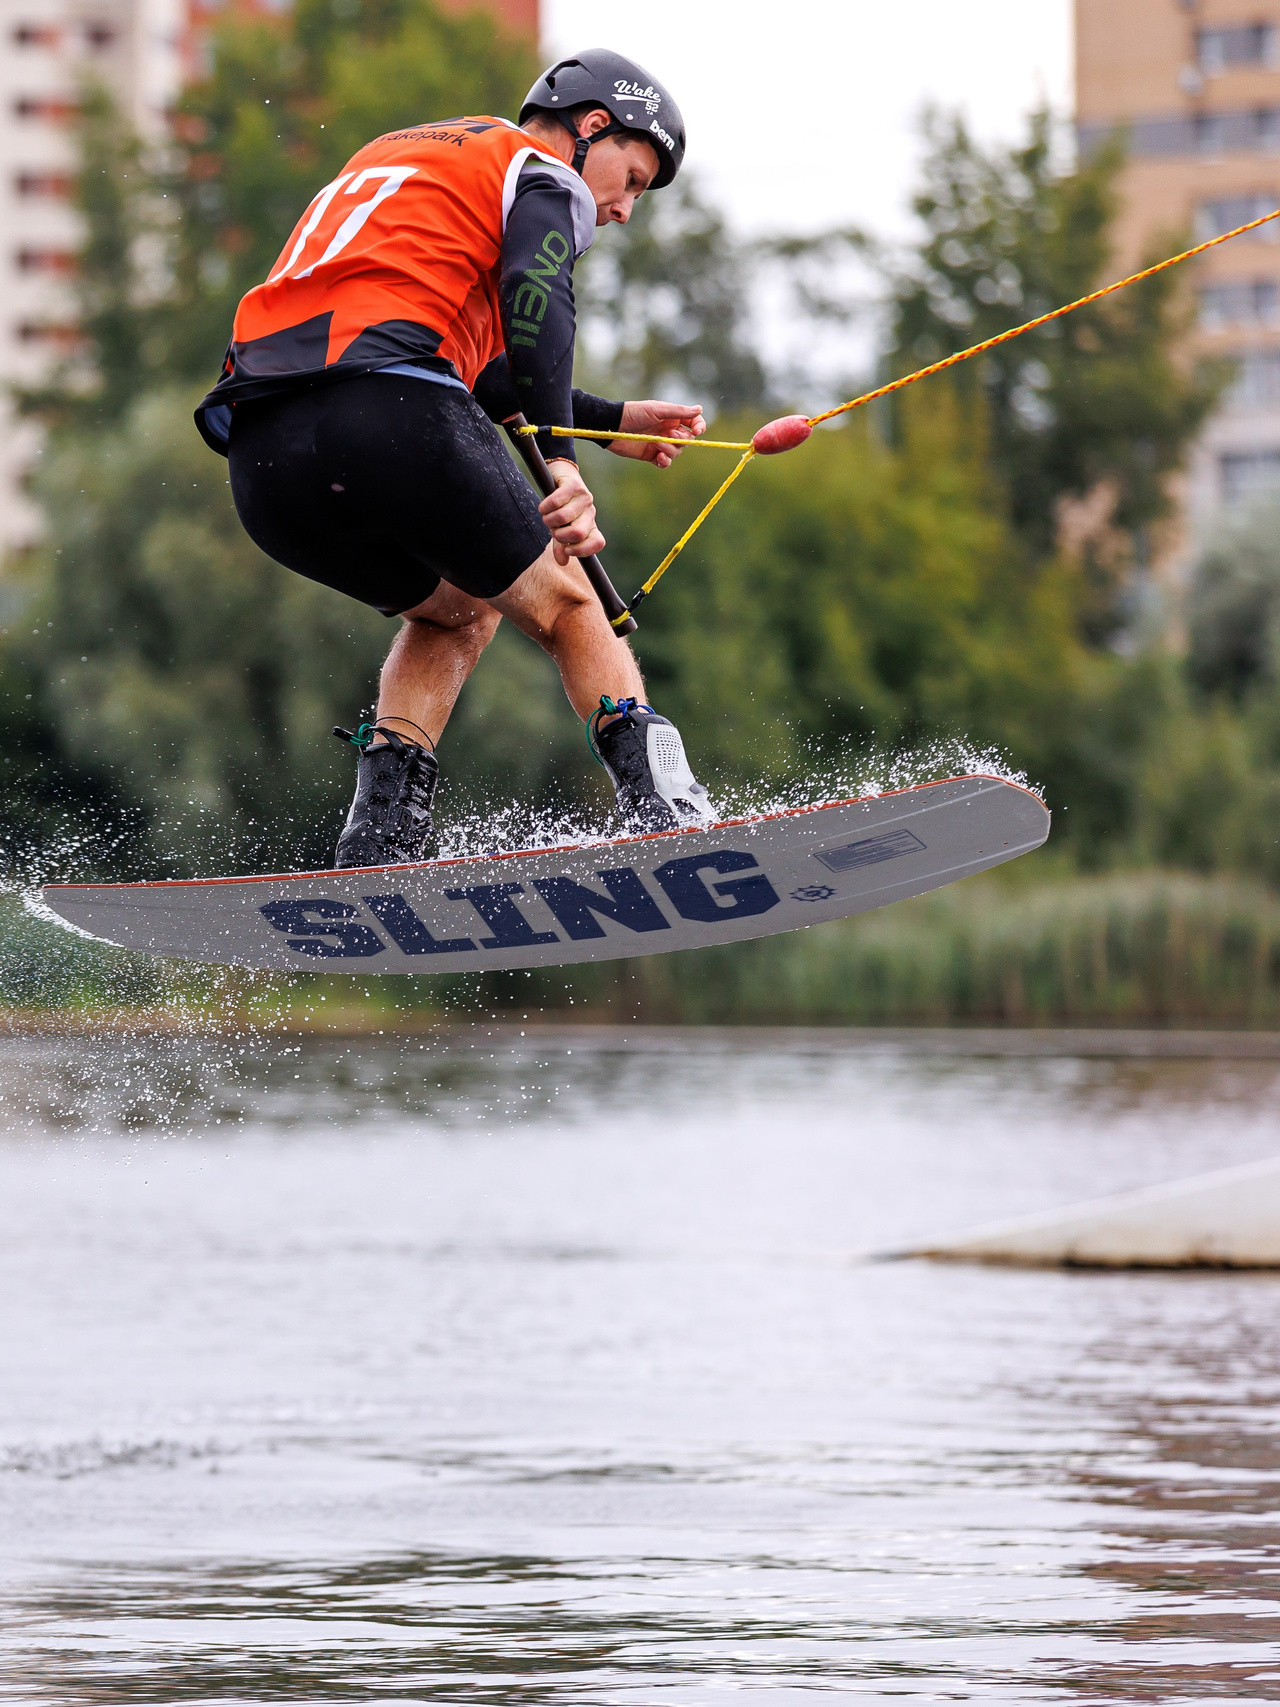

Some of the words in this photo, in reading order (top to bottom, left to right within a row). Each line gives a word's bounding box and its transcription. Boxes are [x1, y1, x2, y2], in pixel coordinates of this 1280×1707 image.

[612, 79, 661, 103] Wake
[645, 101, 660, 113] 52
[269, 165, 420, 283] 17
[258, 849, 781, 958] SLING
